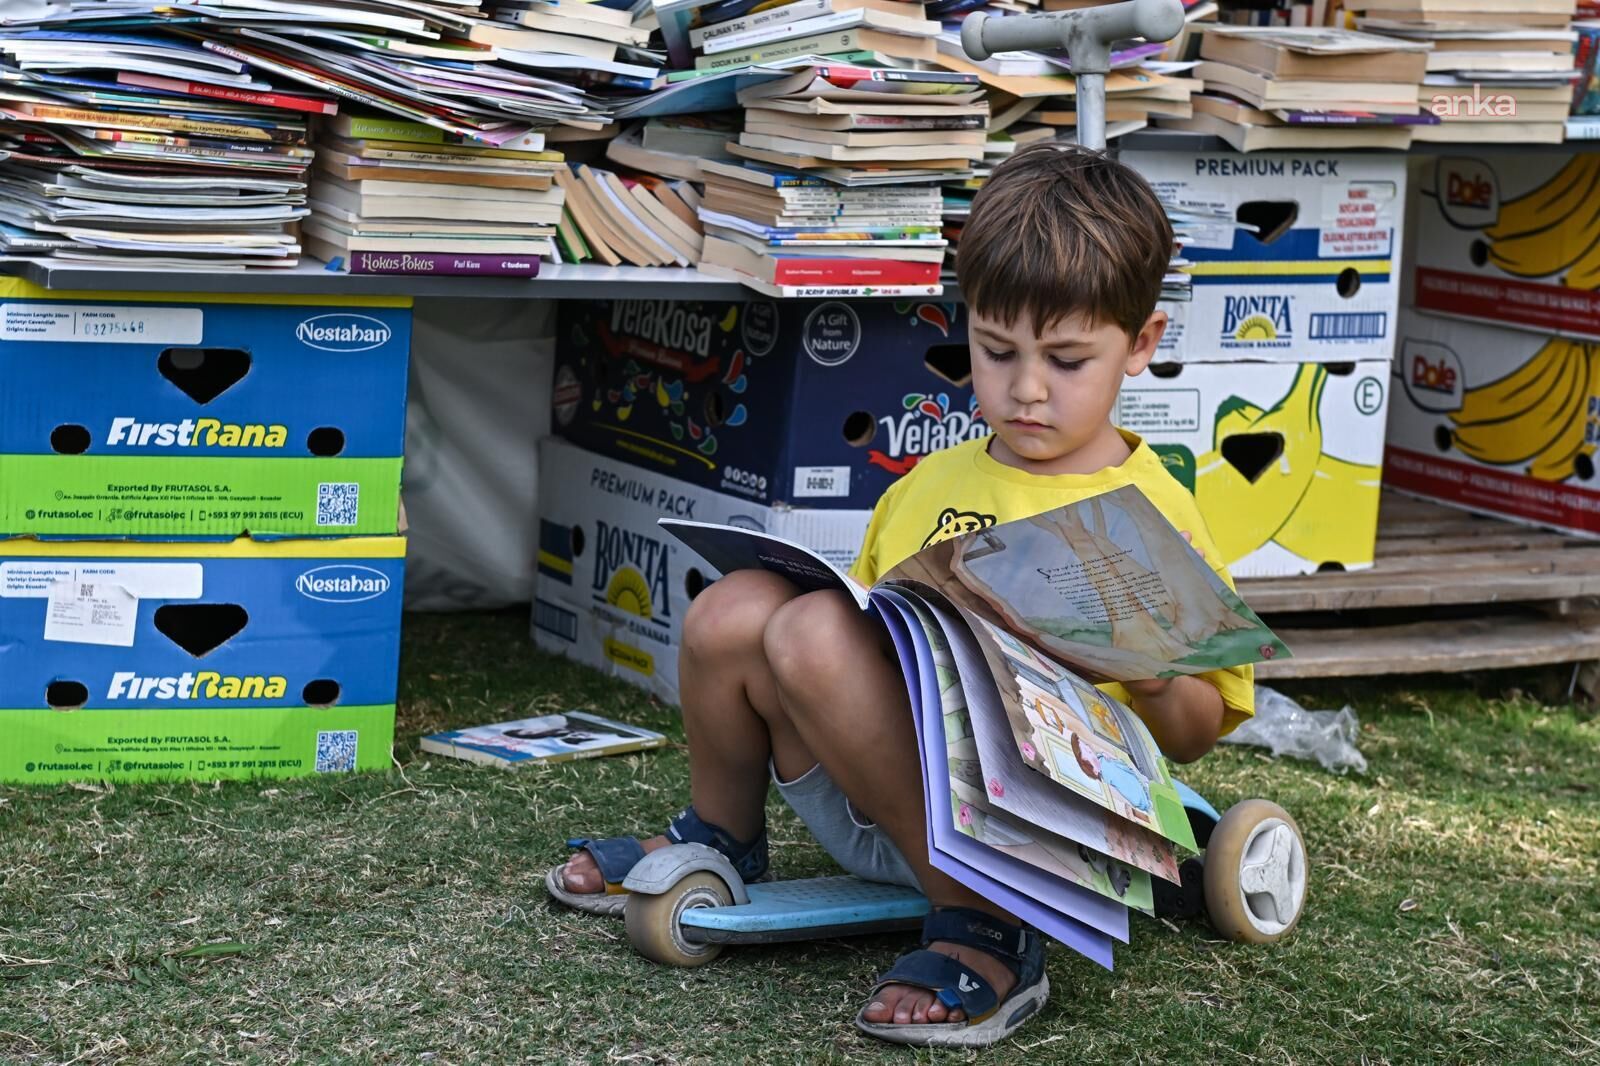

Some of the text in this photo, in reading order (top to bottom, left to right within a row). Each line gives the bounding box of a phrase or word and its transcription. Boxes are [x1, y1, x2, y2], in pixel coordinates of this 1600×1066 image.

[703, 26, 732, 40] ÇALINAN
[733, 22, 746, 33] TAÇ
[753, 15, 770, 24] MARK
[771, 10, 790, 20] TWAIN
[1195, 158, 1339, 176] PREMIUM PACK
[1447, 172, 1492, 203] Dole
[361, 253, 399, 272] Hokus
[400, 254, 434, 271] Pokus
[454, 260, 466, 269] Paul
[817, 313, 848, 326] A Gift
[1221, 295, 1292, 333] BONITA
[299, 322, 388, 342] Nestaban
[811, 338, 852, 351] Nature
[1220, 341, 1254, 349] PREMIUM
[1413, 356, 1456, 390] Dole
[1362, 382, 1375, 409] E
[879, 411, 992, 457] VelaRo
[107, 484, 232, 493] Exported By FRUTASOL S.A.
[590, 469, 654, 507] PREMIUM
[657, 489, 697, 518] PACK
[38, 509, 304, 521] frutasol.ec @frutasolec +593 97 991 2615 (ECU)
[592, 520, 671, 618] BONITA
[299, 574, 387, 592] Nestaban
[107, 736, 149, 745] Exported
[151, 737, 163, 745] By
[165, 736, 212, 744] FRUTASOL
[38, 762, 93, 771] frutasol.ec
[123, 761, 184, 772] @frutasolec
[278, 759, 302, 768] (ECU)
